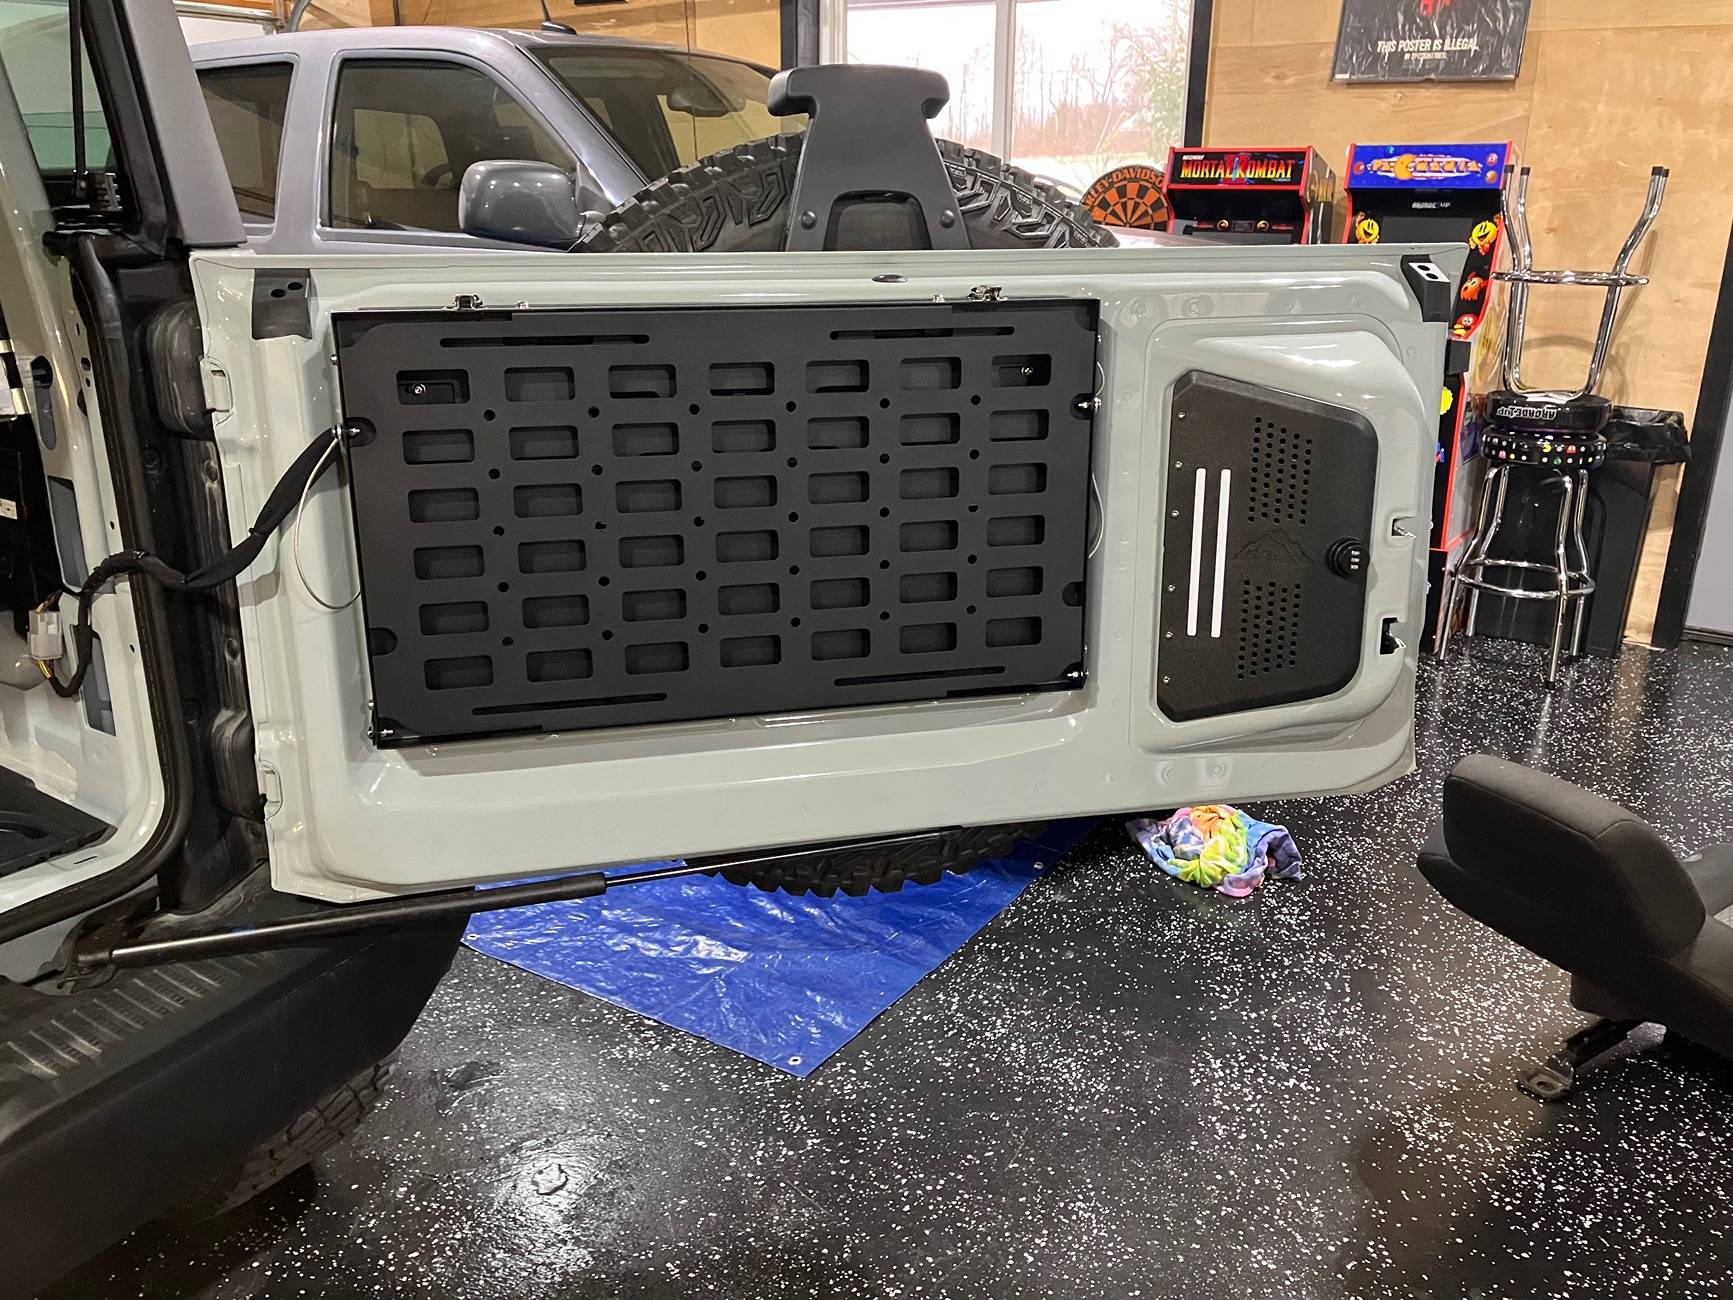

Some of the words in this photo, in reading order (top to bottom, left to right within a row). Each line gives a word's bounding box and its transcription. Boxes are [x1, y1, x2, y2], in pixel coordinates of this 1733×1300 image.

[1377, 40, 1397, 52] THIS
[1398, 39, 1431, 52] POSTER
[1433, 39, 1443, 51] IS
[1444, 38, 1479, 51] ILLEGAL
[1180, 160, 1233, 178] MORTAL
[1235, 160, 1293, 178] KOMBAT
[1083, 168, 1165, 207] RLEY-DAVIDSO
